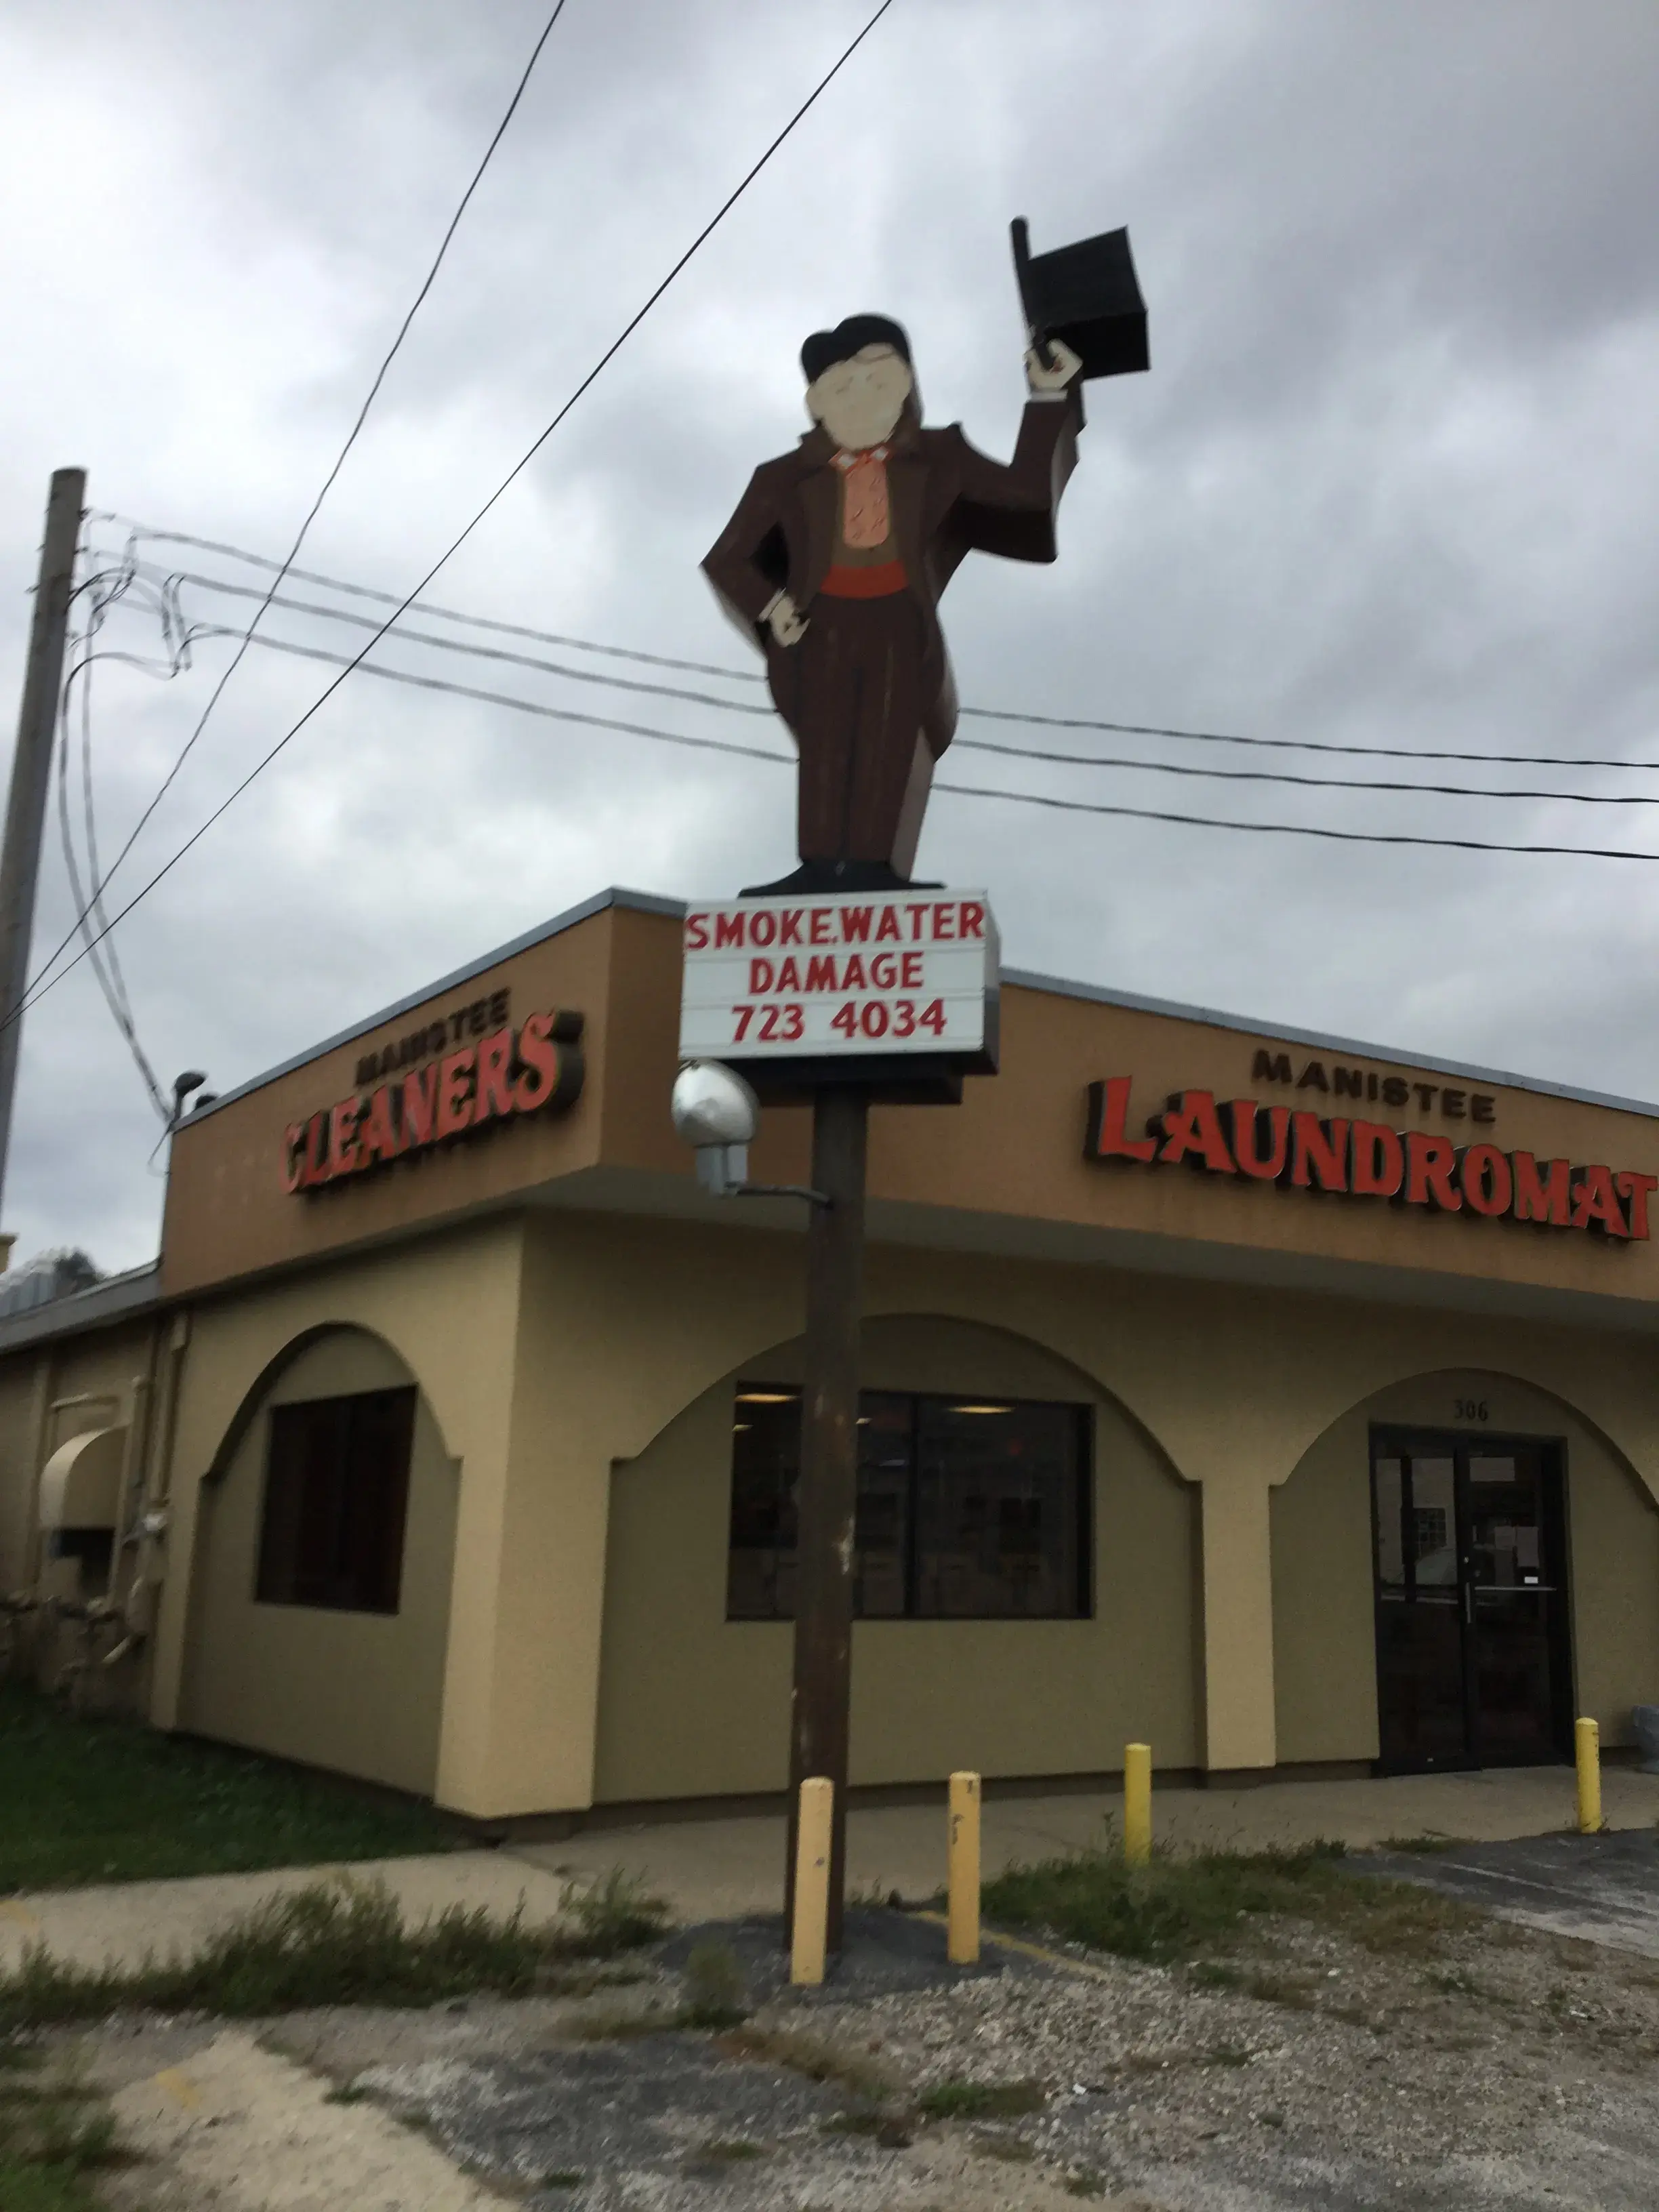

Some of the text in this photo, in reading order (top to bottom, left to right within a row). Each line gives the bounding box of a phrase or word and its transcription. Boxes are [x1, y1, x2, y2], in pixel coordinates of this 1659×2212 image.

[749, 951, 924, 995] DAMAGE
[730, 999, 946, 1044] 723 4034
[279, 1008, 580, 1195] CLEANERS
[1252, 1049, 1496, 1123] MANISTEE
[1088, 1076, 1658, 1240] LAUNDROMAT
[1453, 1398, 1489, 1422] 306
